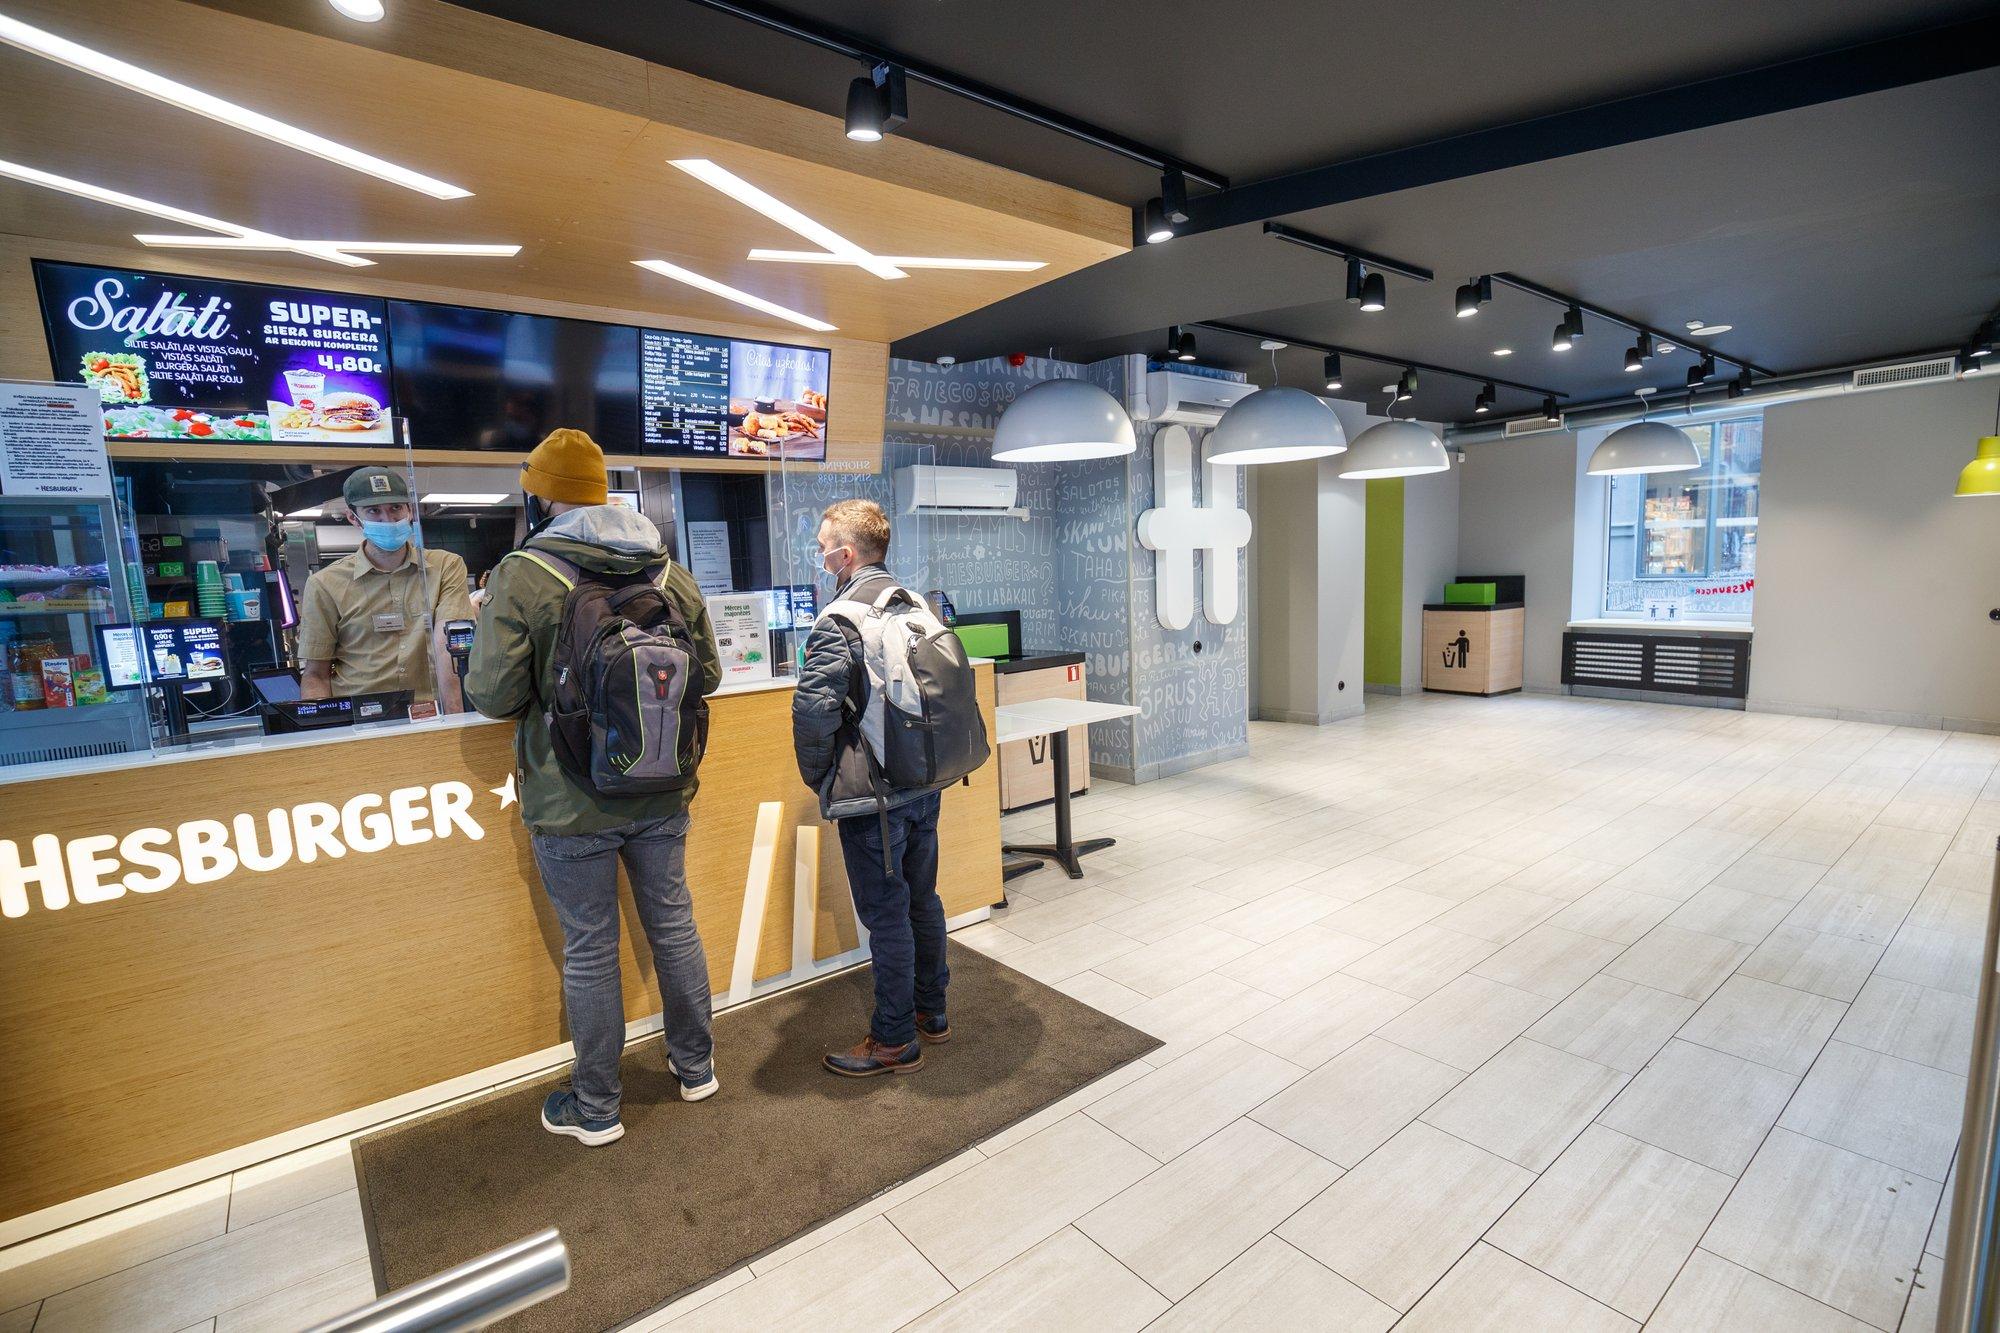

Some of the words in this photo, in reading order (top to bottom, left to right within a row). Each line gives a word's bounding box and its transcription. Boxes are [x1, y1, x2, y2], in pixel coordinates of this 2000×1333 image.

[269, 301, 381, 330] SUPER-
[264, 325, 308, 338] SIERA
[313, 329, 379, 343] BURGERA
[124, 340, 149, 349] SILTIE
[184, 344, 195, 352] AR
[265, 337, 279, 345] AR
[281, 338, 321, 348] BEKONU
[323, 342, 378, 352] KOMPLEKTS
[161, 352, 192, 362] VISTAS
[317, 354, 382, 373] 4,80€
[150, 371, 173, 380] SILTIE
[206, 374, 218, 382] AR
[946, 560, 1031, 587] HESBURGER
[183, 627, 217, 635] SUPER-
[0, 781, 485, 918] HESBURGER
